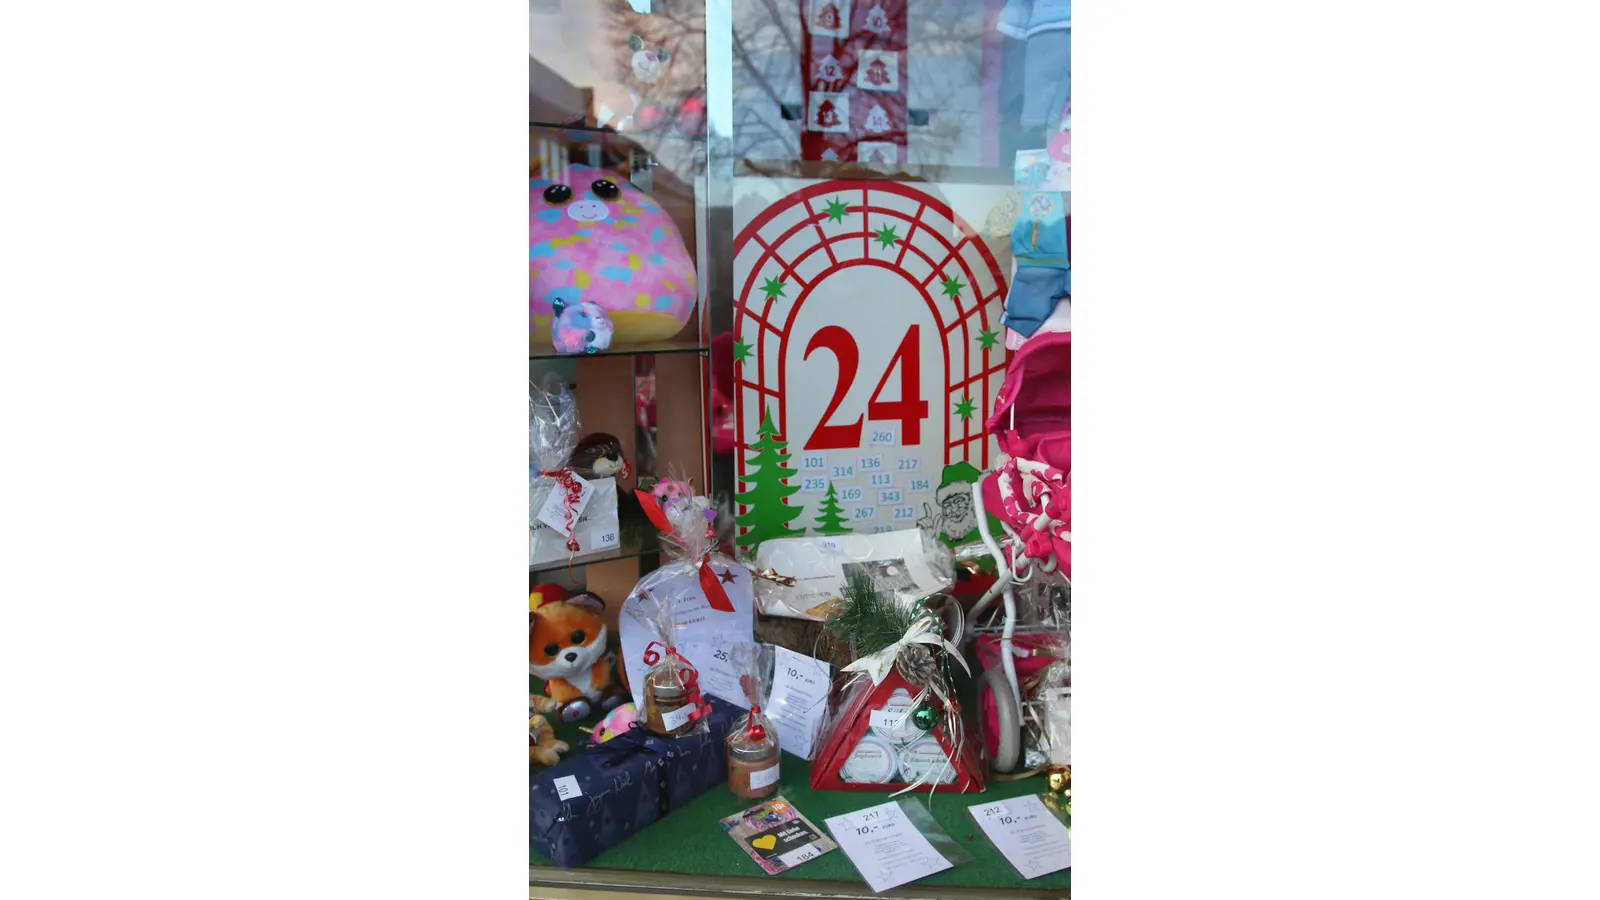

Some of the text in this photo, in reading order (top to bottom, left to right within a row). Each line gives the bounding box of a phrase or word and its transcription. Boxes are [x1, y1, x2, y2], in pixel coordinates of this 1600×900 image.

[825, 65, 836, 77] 12
[803, 324, 928, 450] 24
[872, 431, 893, 442] 260
[804, 457, 824, 468] 101
[861, 458, 881, 469] 136
[898, 459, 918, 470] 217
[833, 466, 853, 477] 314
[805, 479, 825, 490] 235
[871, 474, 891, 485] 113
[911, 479, 929, 491] 184
[841, 488, 862, 499] 169
[880, 491, 900, 502] 343
[854, 507, 874, 519] 267
[894, 507, 914, 519] 212
[601, 533, 615, 543] 136
[558, 785, 570, 796] 101
[862, 810, 879, 821] 217
[983, 805, 1001, 817] 212
[796, 851, 814, 862] 184
